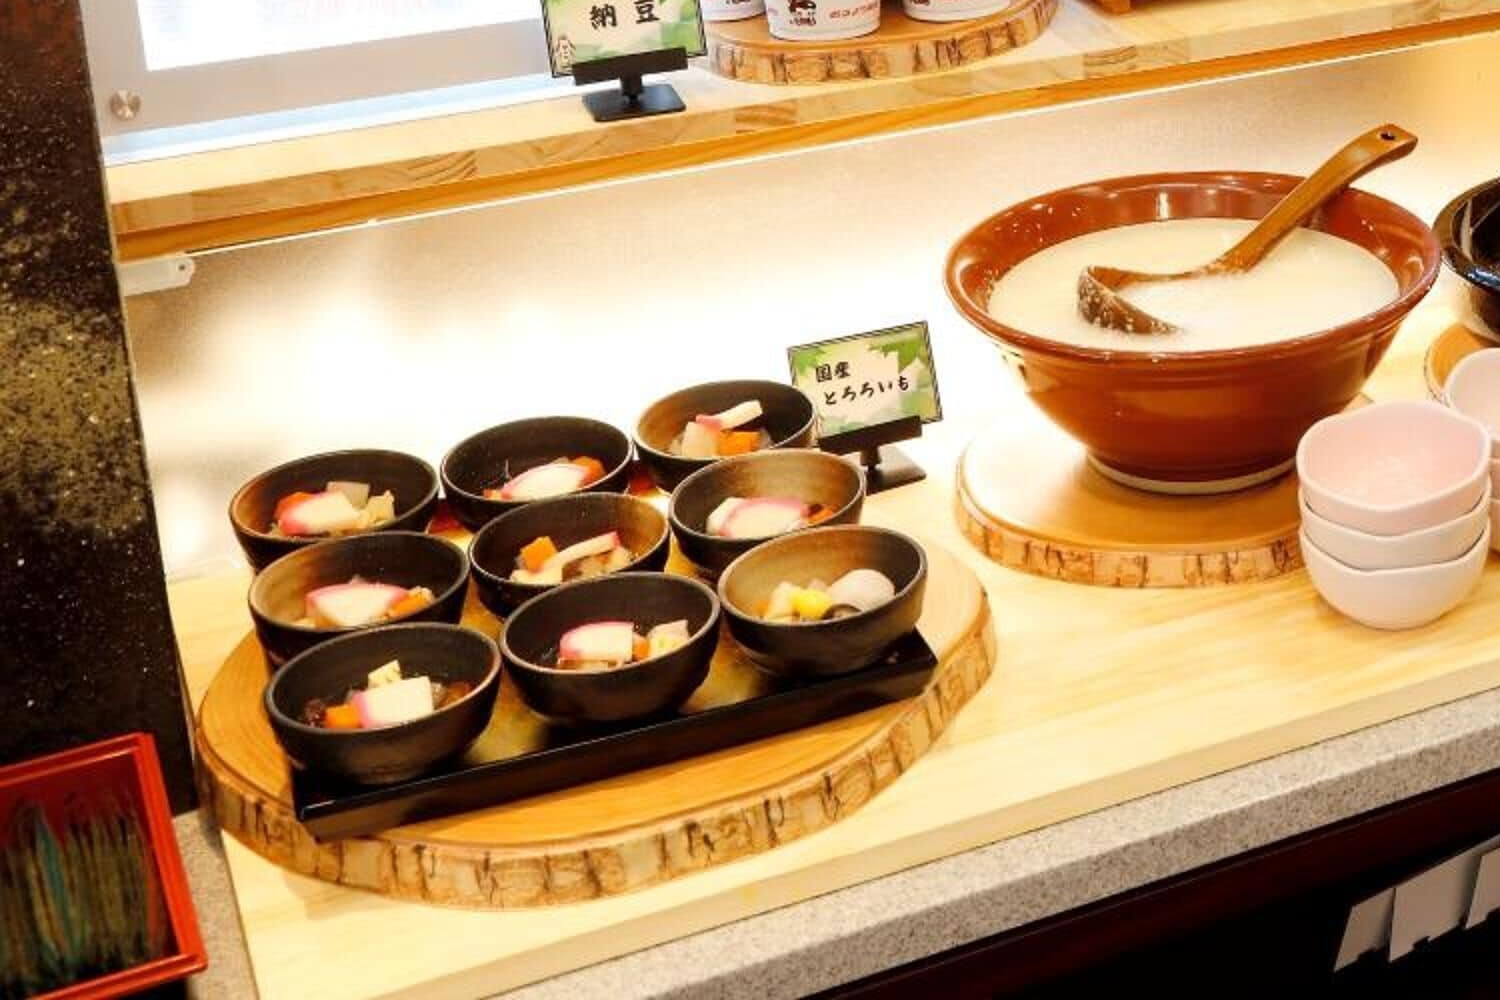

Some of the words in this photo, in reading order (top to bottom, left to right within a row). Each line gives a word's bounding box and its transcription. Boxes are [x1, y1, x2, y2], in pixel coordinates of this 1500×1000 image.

[815, 361, 851, 383] 国産
[823, 376, 909, 406] とろろいも
